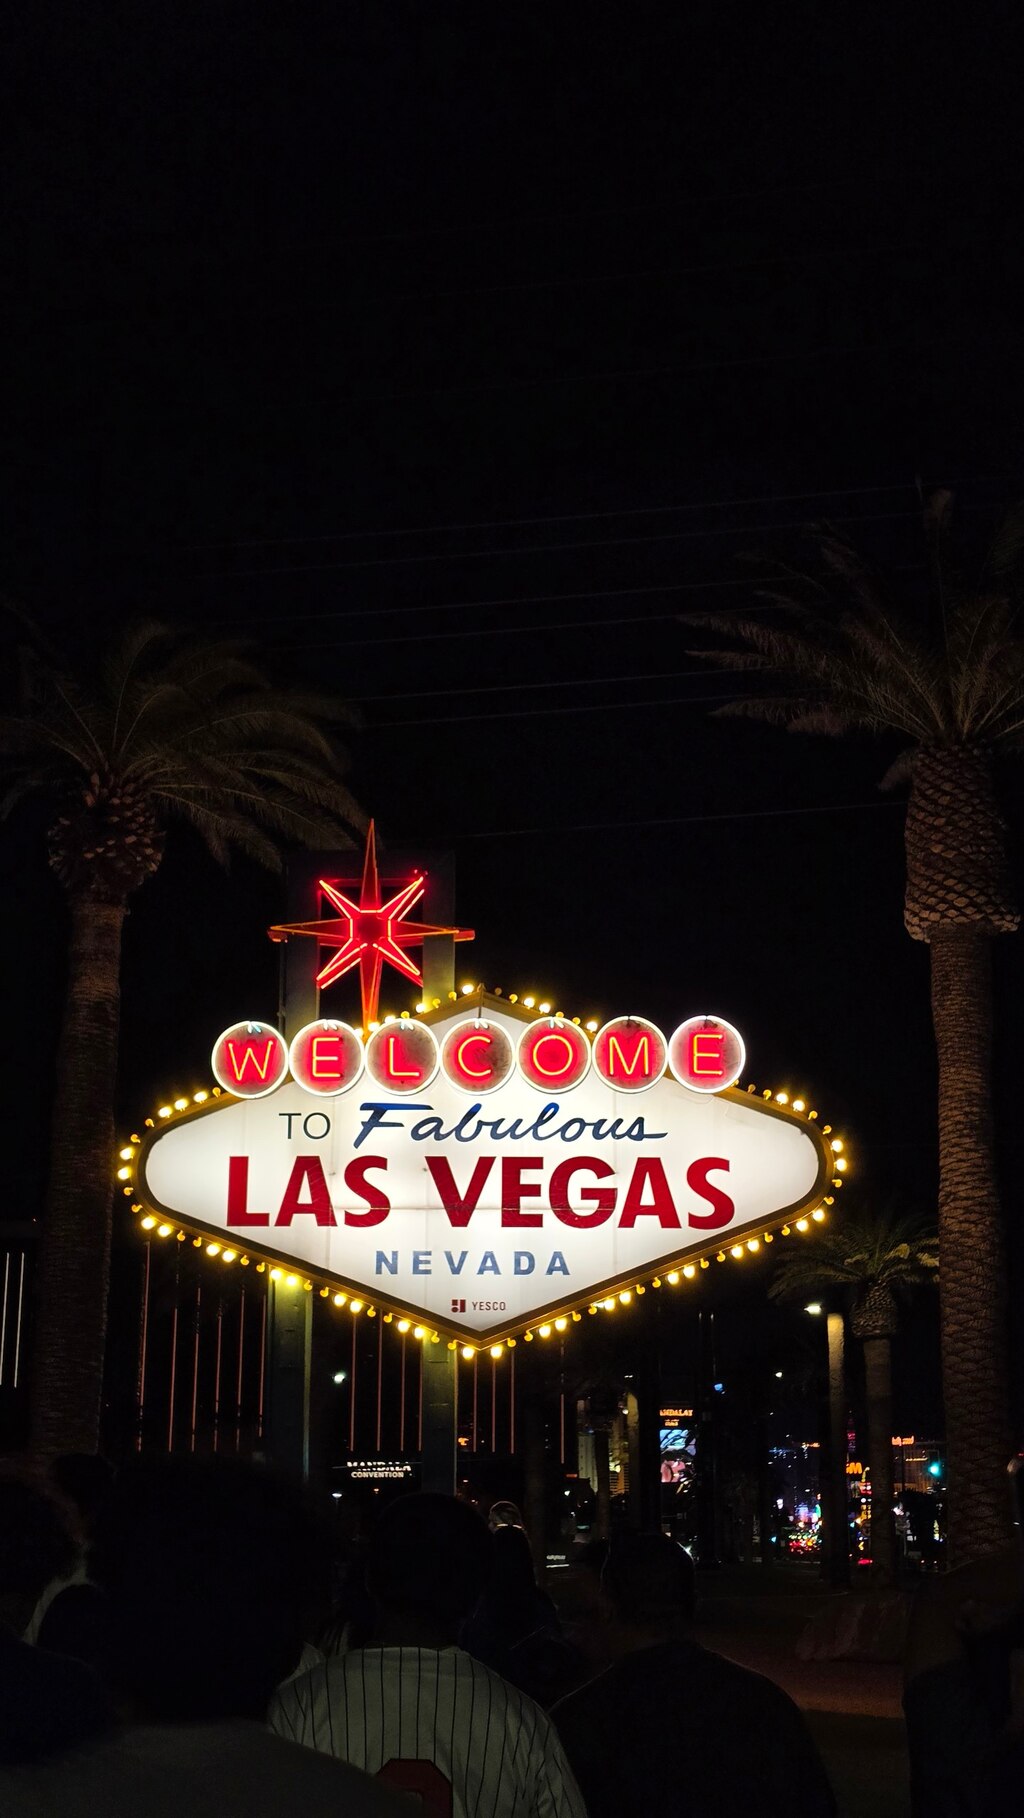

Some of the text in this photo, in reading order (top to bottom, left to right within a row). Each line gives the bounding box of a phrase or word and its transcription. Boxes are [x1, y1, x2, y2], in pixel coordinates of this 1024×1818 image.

[225, 1031, 725, 1084] WELCOME
[278, 1102, 669, 1149] TO Fabulous
[226, 1155, 737, 1230] LAS VEGAS
[375, 1250, 571, 1277] NEVADA
[471, 1301, 506, 1312] YESCO
